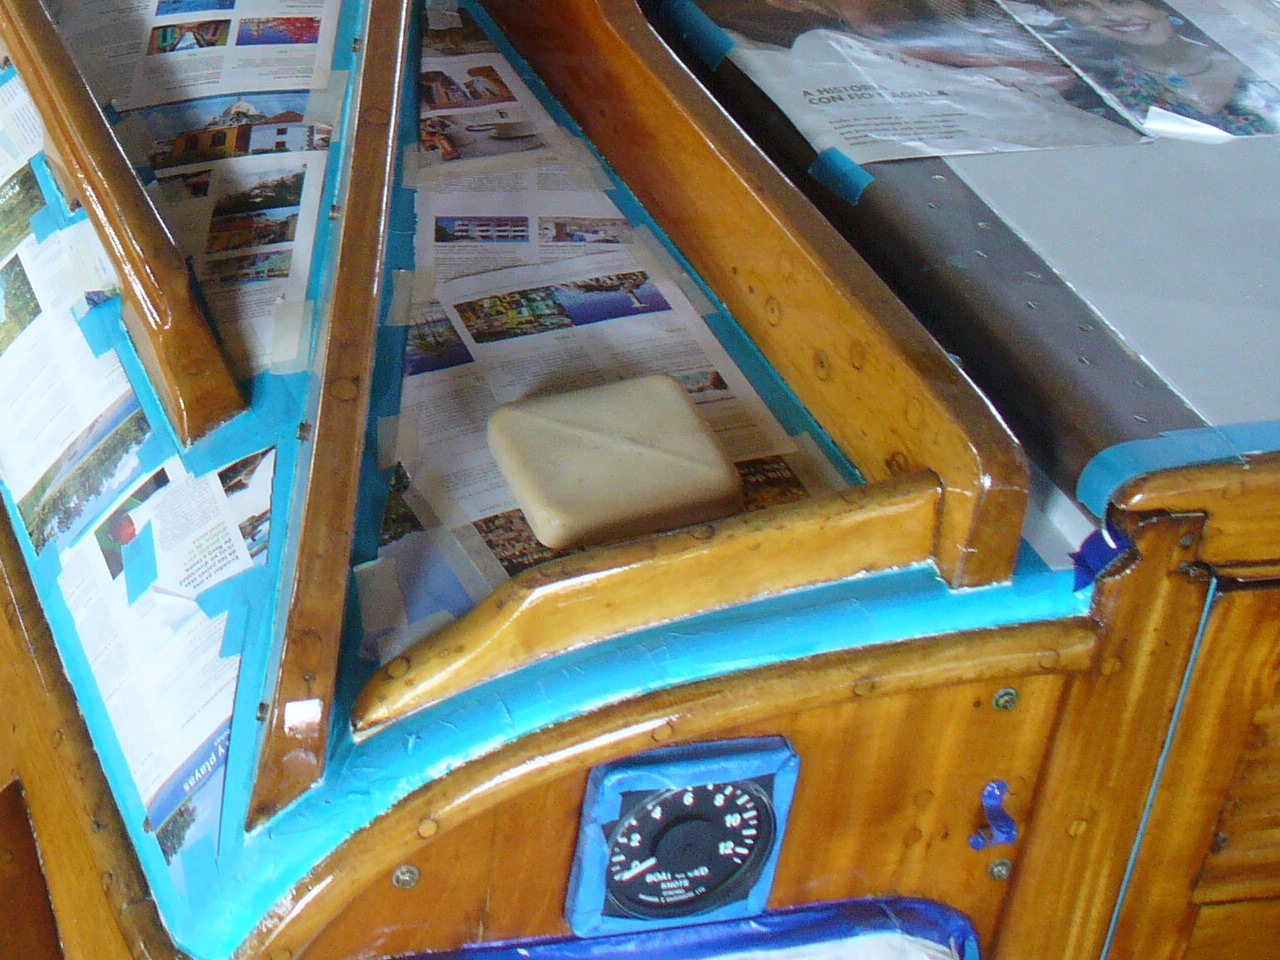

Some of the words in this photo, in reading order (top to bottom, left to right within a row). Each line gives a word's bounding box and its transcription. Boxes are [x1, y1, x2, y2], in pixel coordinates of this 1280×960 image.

[183, 751, 218, 793] playas
[682, 791, 694, 806] 6
[713, 793, 725, 807] 8
[651, 806, 662, 819] 4
[724, 813, 741, 828] 10
[630, 833, 641, 847] 2
[719, 840, 734, 855] 12
